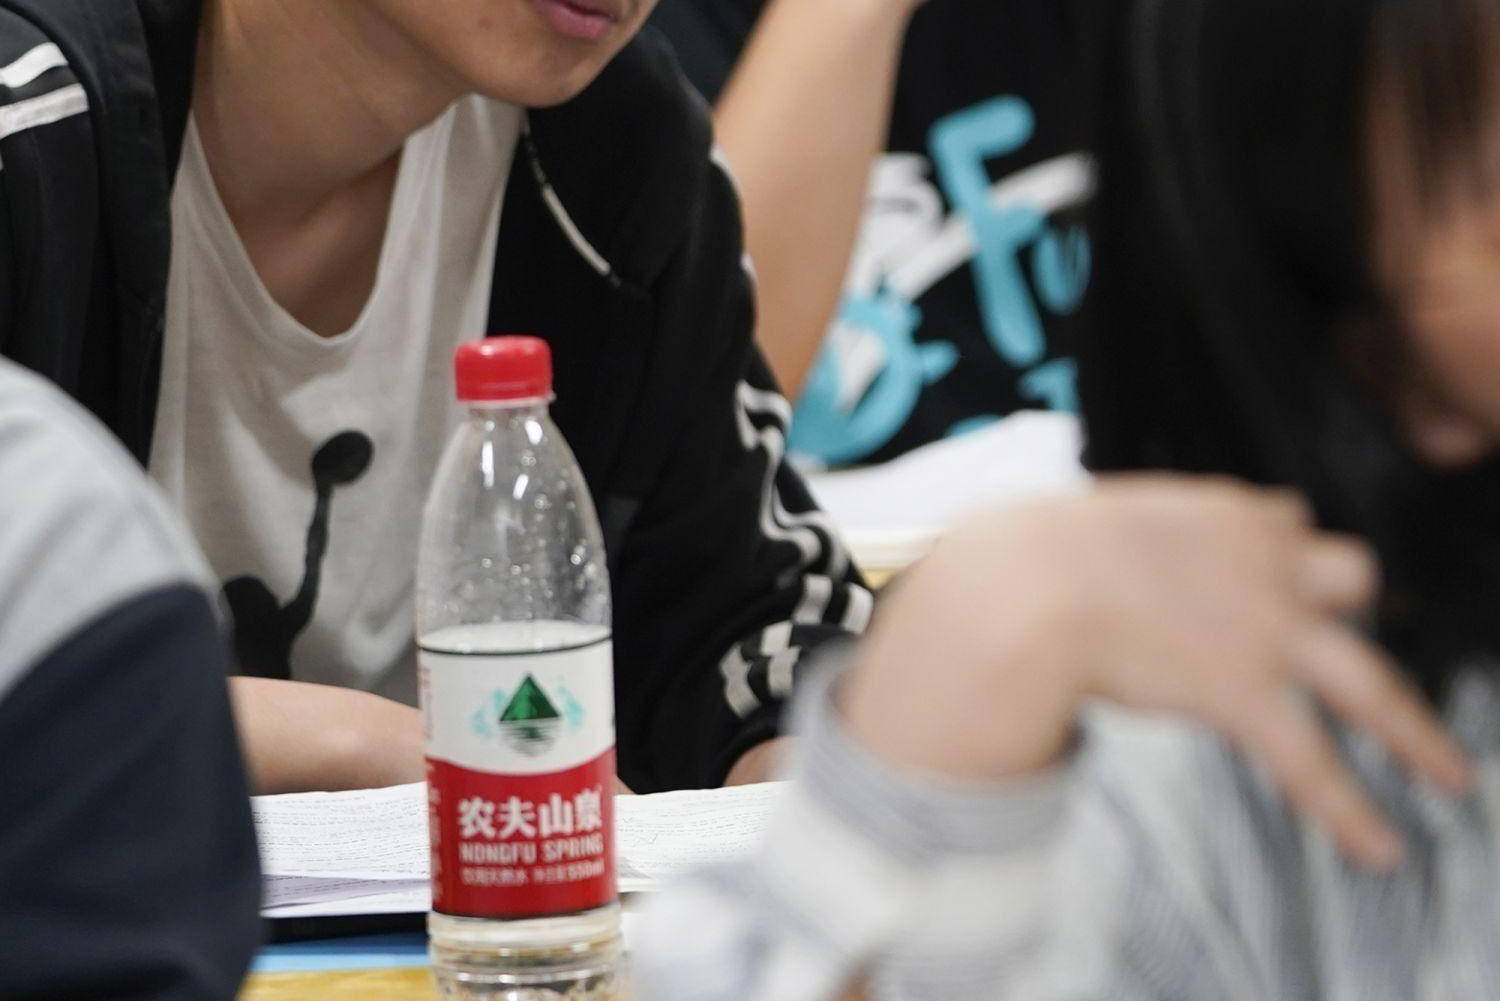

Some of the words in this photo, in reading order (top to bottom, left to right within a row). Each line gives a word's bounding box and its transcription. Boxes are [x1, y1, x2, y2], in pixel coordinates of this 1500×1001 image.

[458, 788, 602, 839] 农夫山泉
[459, 841, 537, 864] NONGFU
[541, 831, 604, 862] SPRING
